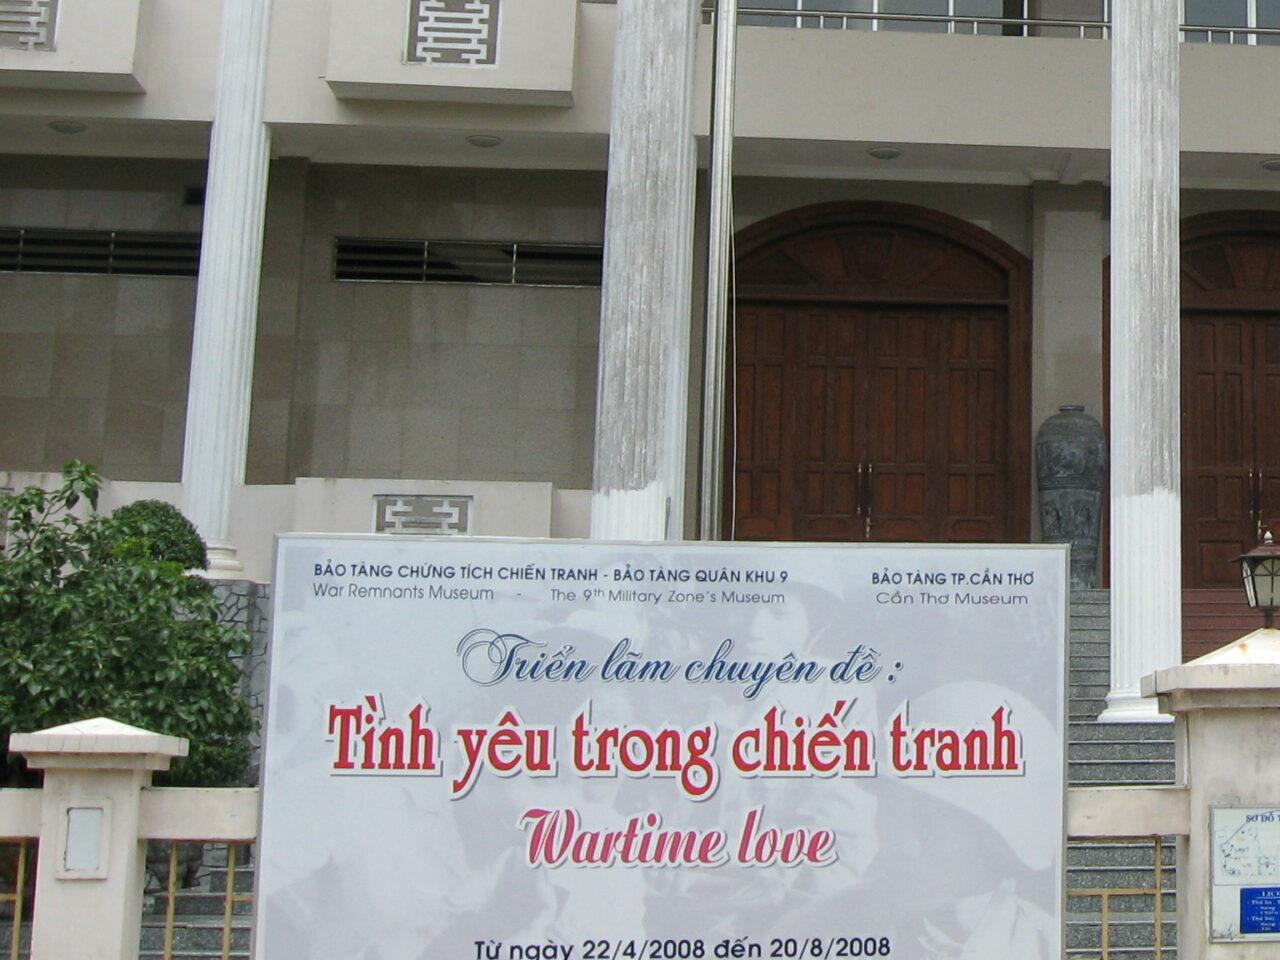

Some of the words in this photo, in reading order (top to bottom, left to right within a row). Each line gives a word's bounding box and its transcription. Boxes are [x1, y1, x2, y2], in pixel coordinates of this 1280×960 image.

[313, 558, 347, 577] BẢO
[351, 562, 393, 578] TÀNG
[397, 562, 456, 579] CHỨNG
[460, 563, 493, 580] TÍCH
[497, 563, 546, 581] CHIẾN
[550, 567, 598, 581] TRANH
[613, 564, 645, 582] BẢO
[649, 566, 690, 582] TÀNG
[694, 567, 741, 583] QUÂN
[745, 570, 775, 583] KHU
[779, 571, 788, 583] 9
[871, 567, 903, 586] BẢO
[906, 570, 947, 586] TÀNG
[1007, 570, 1035, 586] THƠ
[313, 582, 344, 598] War
[349, 583, 424, 600] Remnants
[428, 584, 494, 600] Museum
[550, 588, 577, 602] The
[608, 589, 662, 605] Military
[721, 590, 785, 604] Museum
[876, 590, 914, 605] Cần
[919, 592, 950, 605] Thơ
[954, 592, 1029, 605] Museum
[457, 628, 597, 687] Triển
[600, 637, 680, 684] lãm
[684, 638, 825, 702] chuyên
[328, 695, 437, 771] Tình
[452, 710, 552, 794] yêu
[571, 711, 714, 796] trong
[731, 699, 871, 772] chiến
[890, 705, 1019, 772] tranh
[521, 807, 727, 865] Wartime
[737, 809, 834, 865] love
[474, 939, 502, 960] Từ
[509, 939, 575, 960] ngày
[582, 938, 706, 959] 22/4/2008
[713, 936, 763, 959] đến
[769, 936, 892, 959] 20/8/2008
